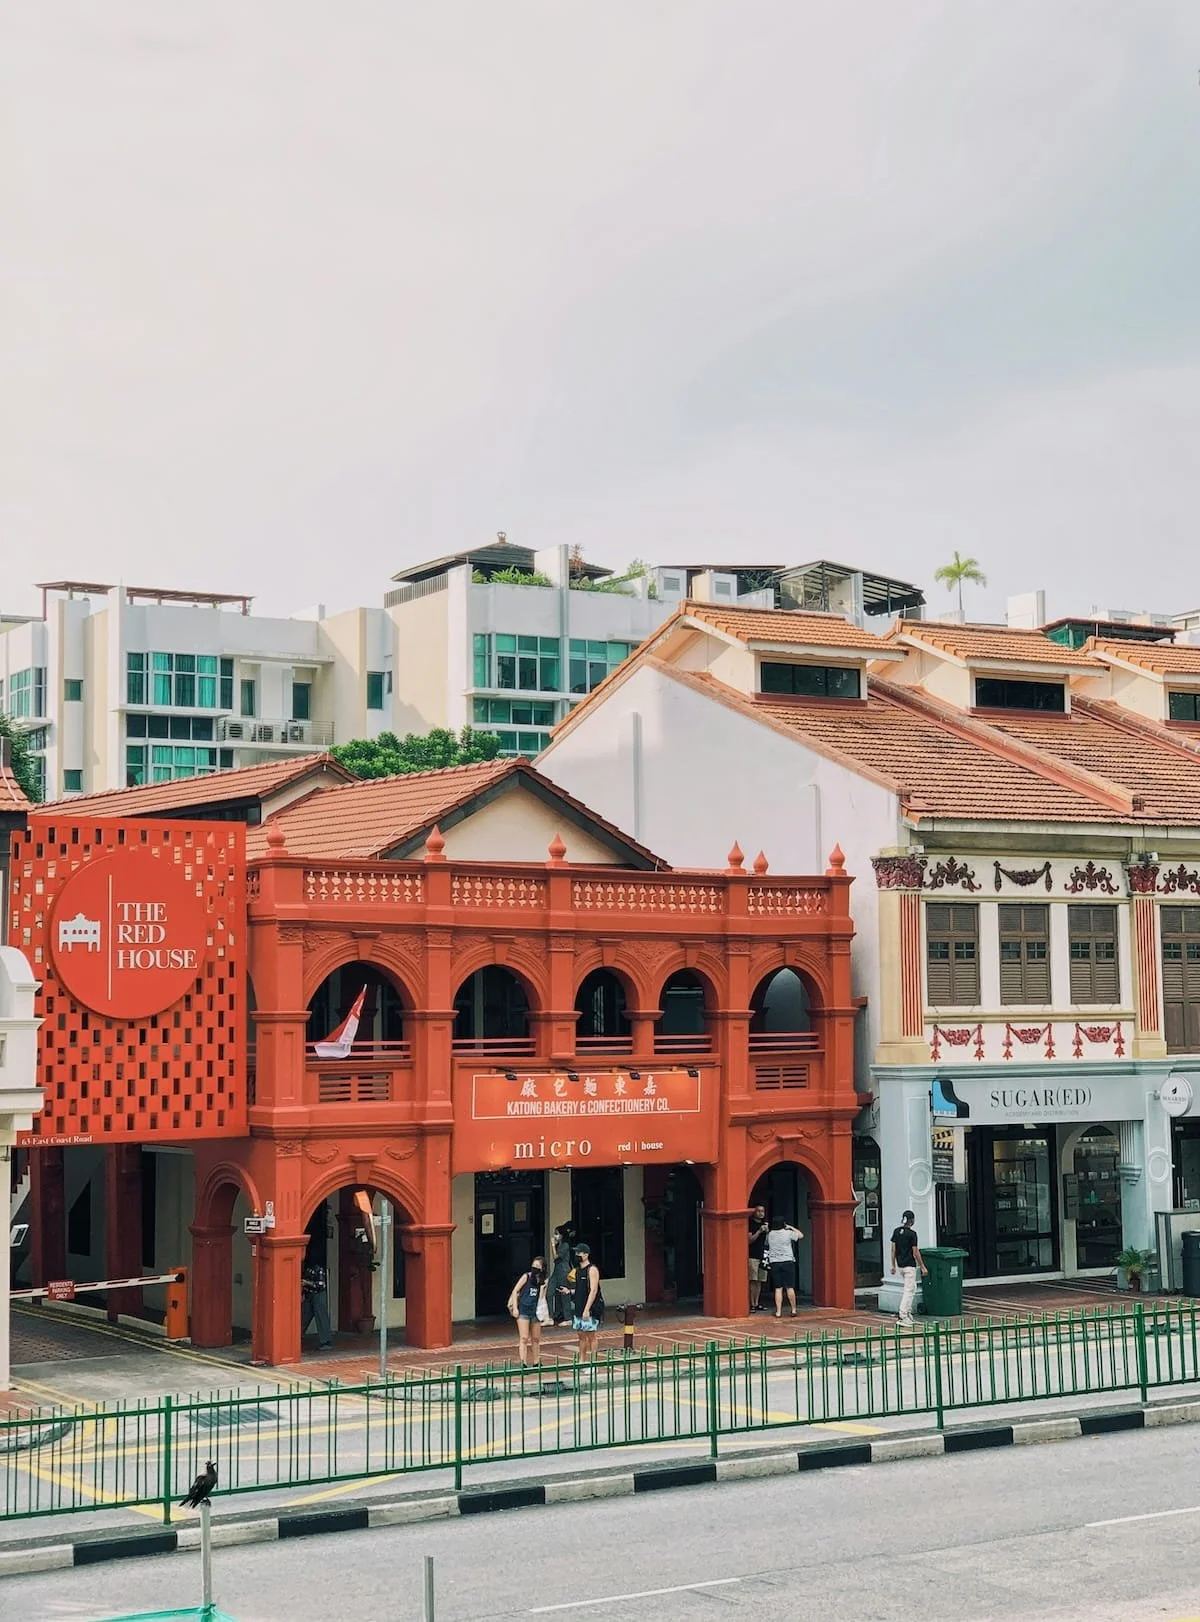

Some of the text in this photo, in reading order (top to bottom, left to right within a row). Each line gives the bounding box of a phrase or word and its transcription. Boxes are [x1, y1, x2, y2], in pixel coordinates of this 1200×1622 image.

[116, 902, 168, 922] THE
[117, 924, 166, 944] RED
[117, 948, 198, 969] HOUSE
[507, 1097, 670, 1115] KATONG BAKERY & CONFECTIONERY CO.
[990, 1086, 1092, 1108] SUGAR(ED)
[21, 1135, 93, 1145] 63 East Coast Road
[514, 1135, 592, 1159] micro
[617, 1141, 664, 1152] red house
